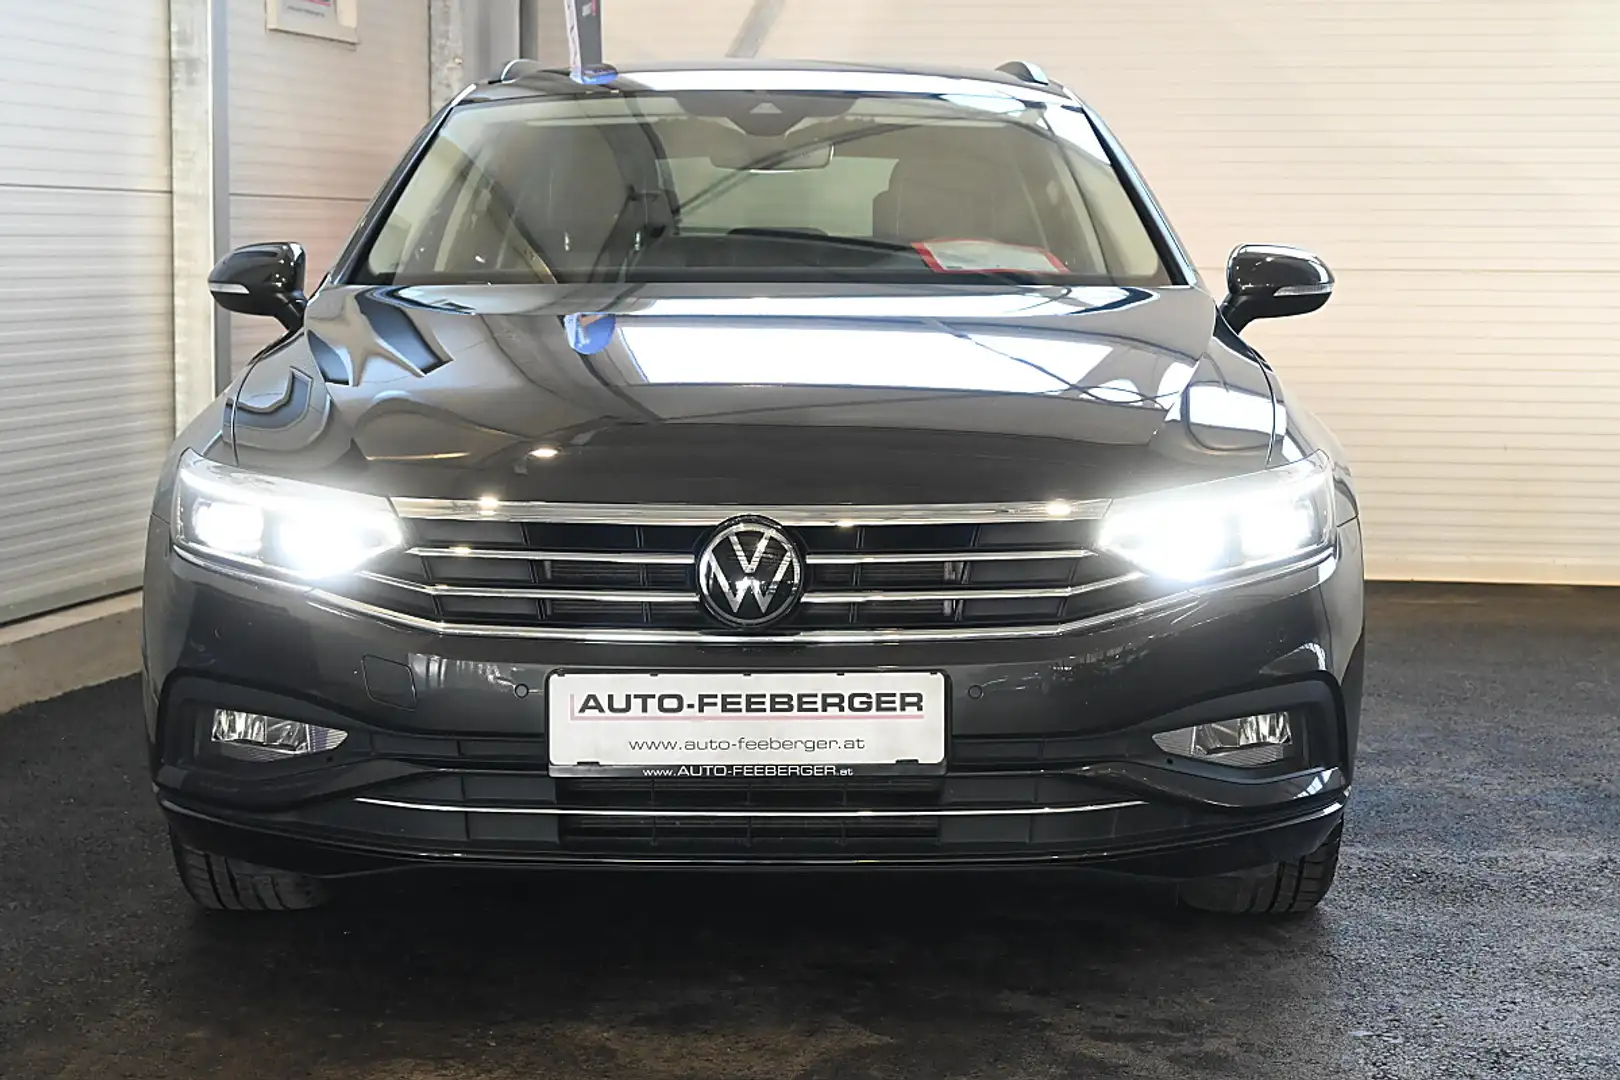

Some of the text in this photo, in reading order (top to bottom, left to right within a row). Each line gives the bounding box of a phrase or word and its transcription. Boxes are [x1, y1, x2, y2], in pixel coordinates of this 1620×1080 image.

[700, 522, 800, 625] VW
[578, 692, 924, 714] AUTO-FEEBERGER
[628, 737, 866, 752] www.auto-feeberger.at
[642, 765, 854, 776] www.AUTO-FEEBERGER.at
